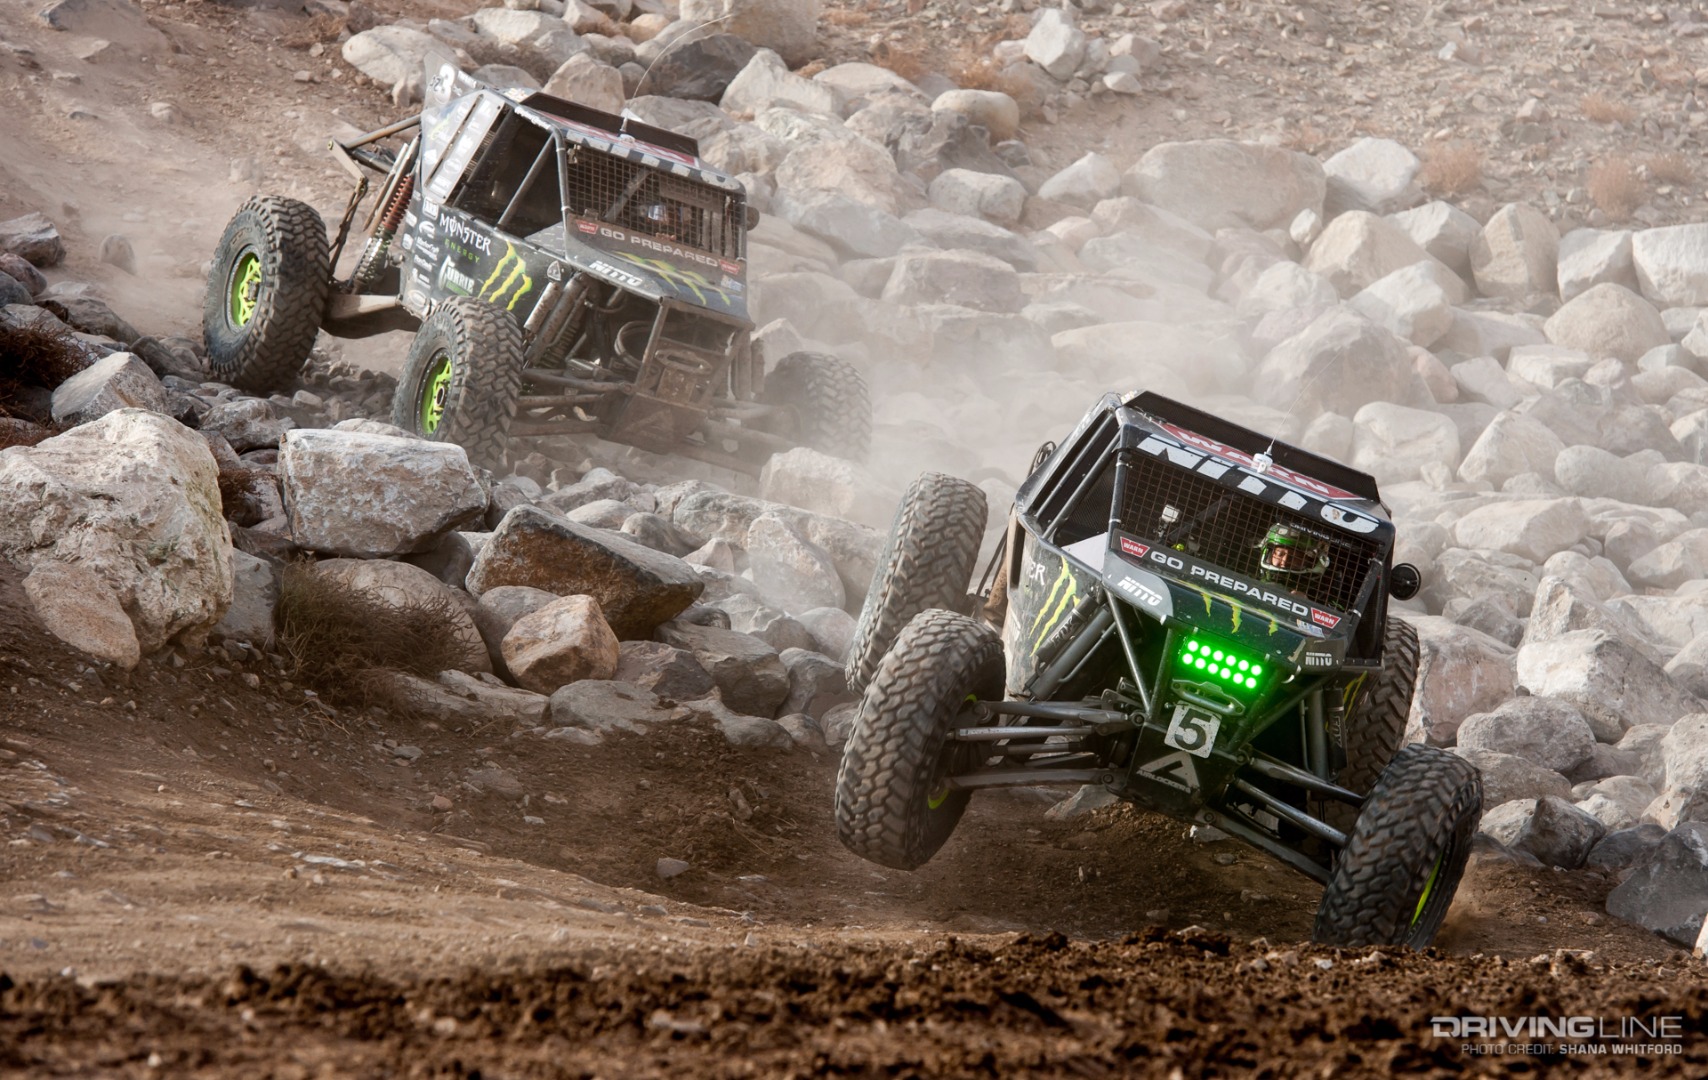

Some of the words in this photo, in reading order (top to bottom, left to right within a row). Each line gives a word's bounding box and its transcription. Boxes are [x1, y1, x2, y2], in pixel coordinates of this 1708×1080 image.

[440, 213, 491, 256] MONSTER
[600, 227, 626, 241] GO
[631, 235, 719, 268] PREPARED
[445, 238, 480, 263] ENERGY
[588, 260, 643, 287] NITTO
[1137, 433, 1381, 534] NITTO
[1123, 541, 1144, 556] WARN
[1117, 576, 1163, 607] NITTO
[1150, 550, 1184, 570] GO
[1190, 565, 1309, 617] PREPARED
[1314, 612, 1335, 625] WARN
[1305, 651, 1333, 667] NITTO
[1174, 707, 1208, 751] 5
